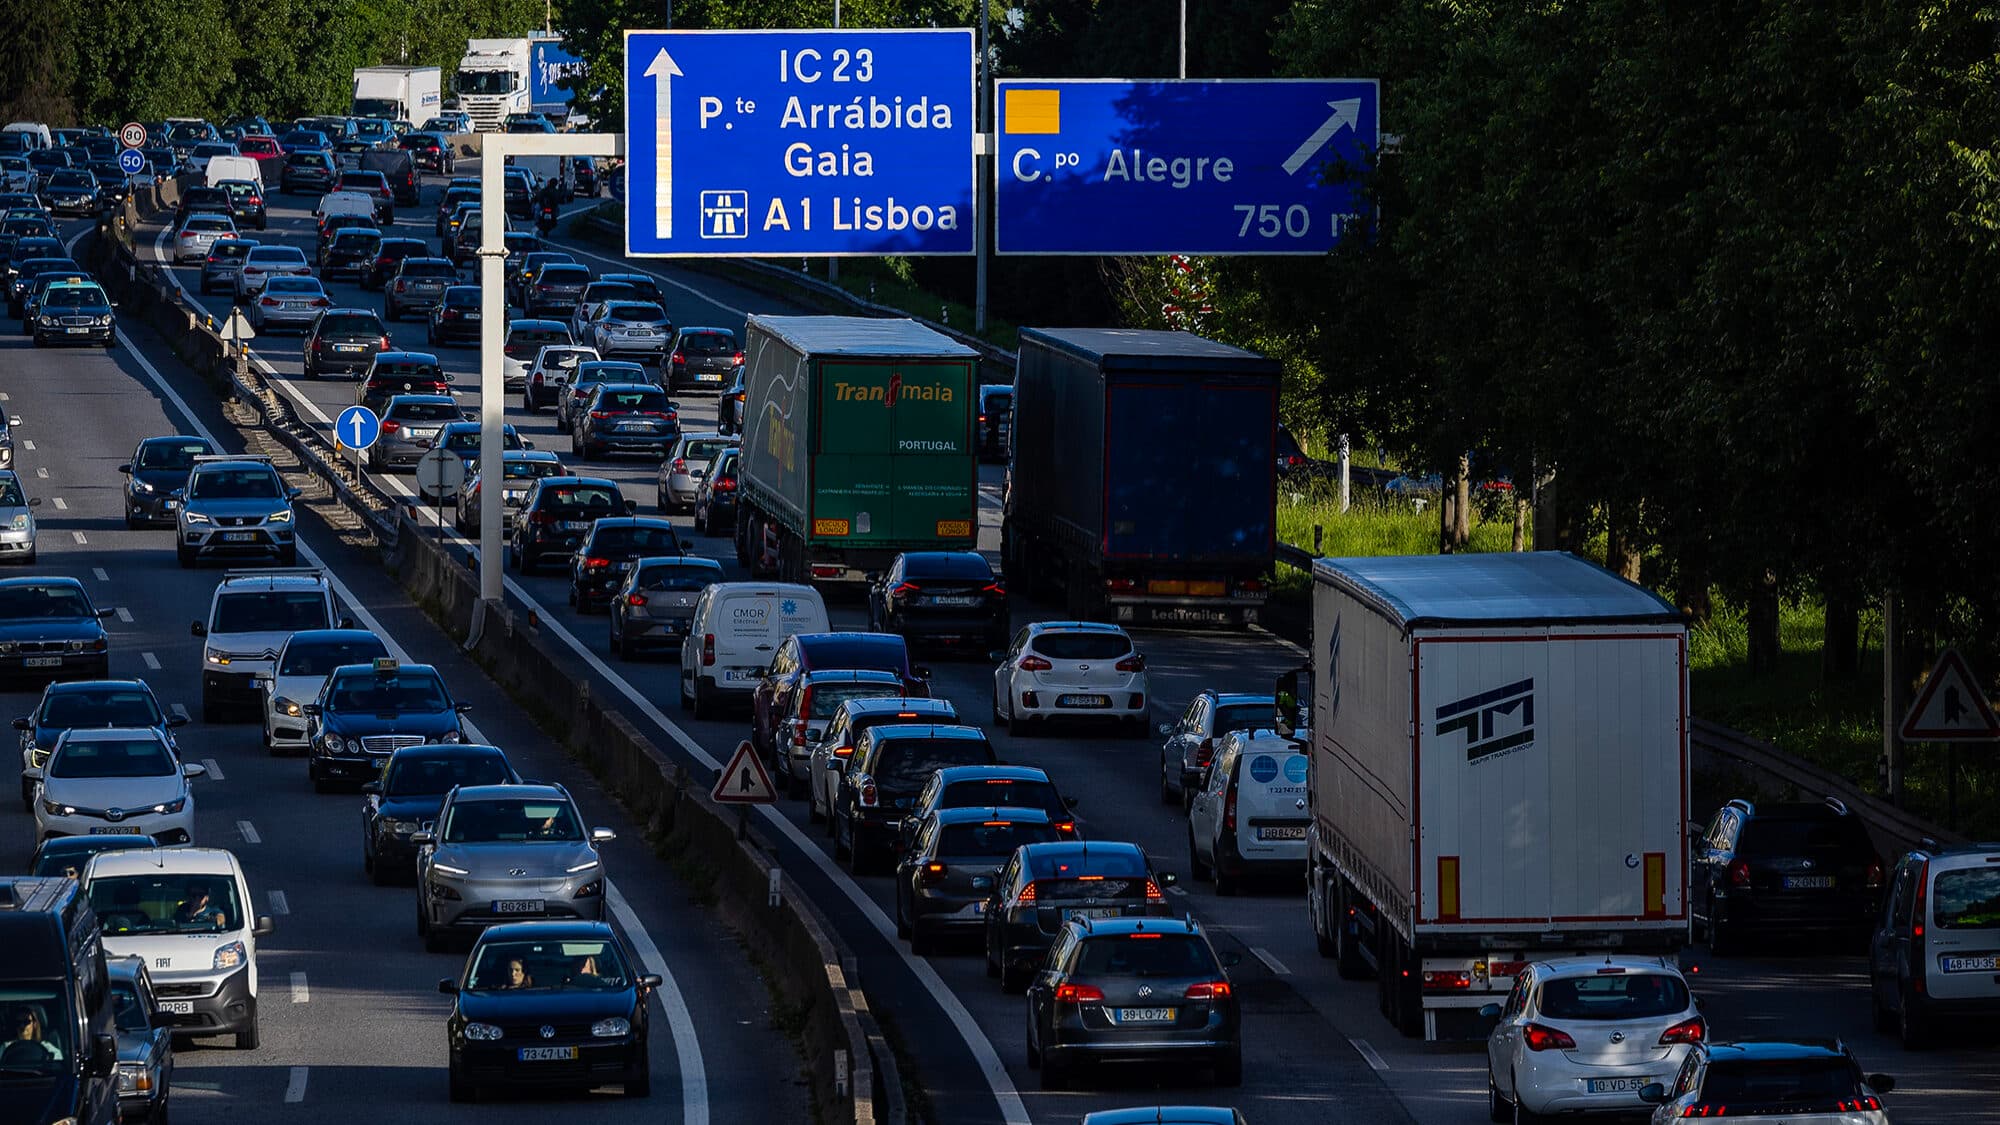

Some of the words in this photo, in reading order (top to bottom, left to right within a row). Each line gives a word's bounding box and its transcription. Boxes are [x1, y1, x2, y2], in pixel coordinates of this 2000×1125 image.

[780, 48, 822, 83] IC
[832, 48, 873, 83] 23
[780, 95, 953, 129] Arrábida
[126, 130, 142, 141] 80
[123, 155, 141, 167] 50
[784, 142, 874, 177] Gaia
[1103, 148, 1235, 188] Alegre
[833, 196, 957, 231] Lisboa
[1234, 204, 1310, 237] 750
[899, 440, 957, 451] PORTUGAL
[733, 608, 765, 619] CMOR
[155, 957, 173, 969] FIAT
